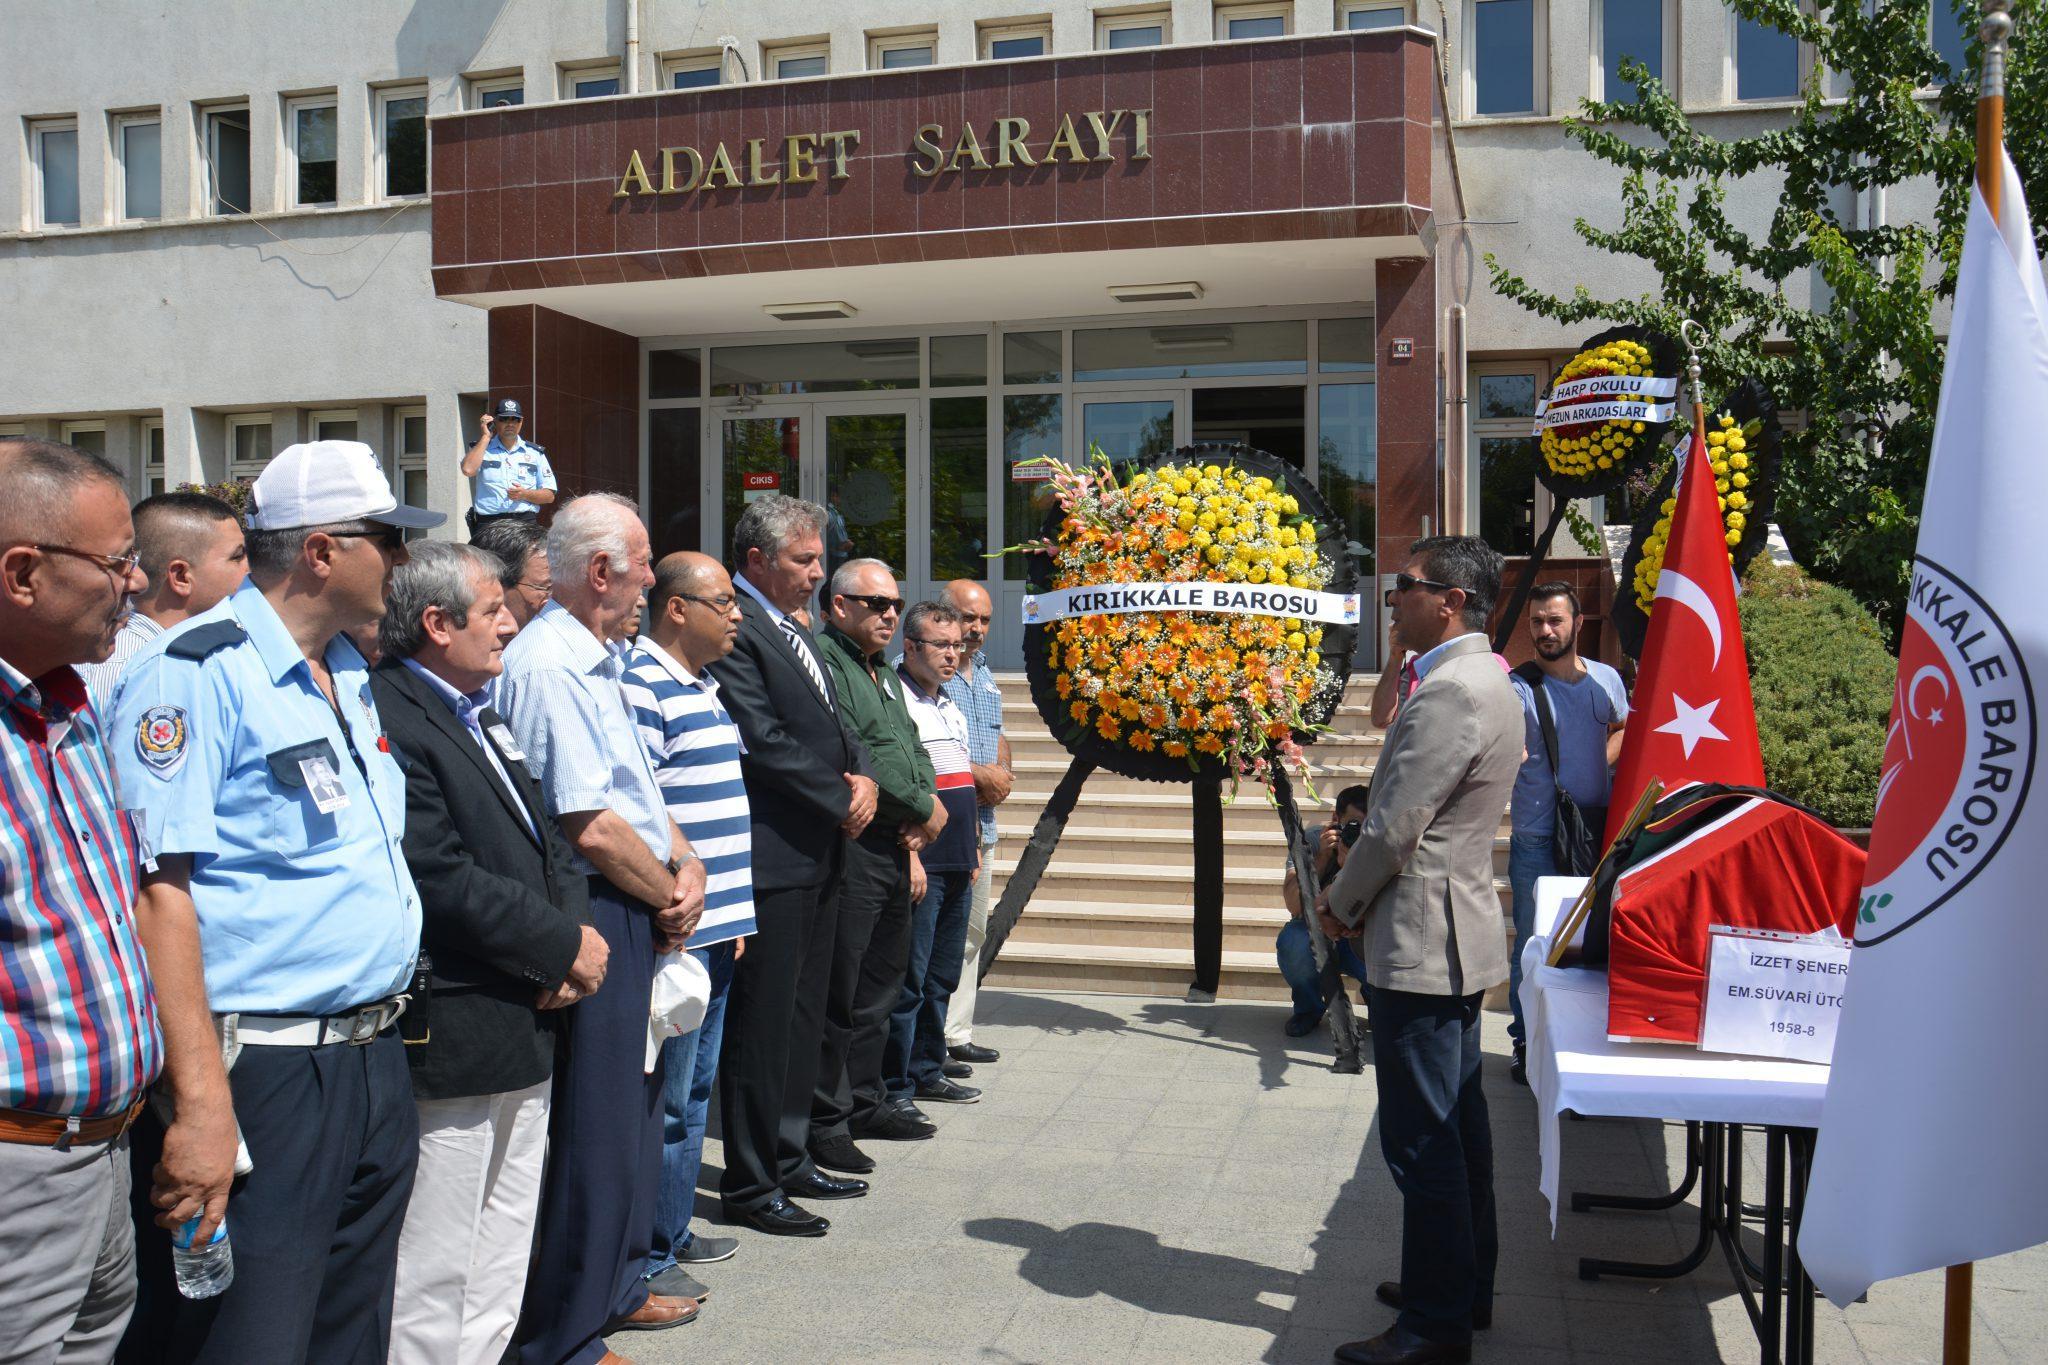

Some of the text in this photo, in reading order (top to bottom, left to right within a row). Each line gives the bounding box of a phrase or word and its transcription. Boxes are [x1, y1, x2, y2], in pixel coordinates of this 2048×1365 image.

[614, 108, 1152, 197] ADALET SARAYI
[1556, 383, 1587, 399] HARP
[1589, 380, 1642, 393] OKULU
[1546, 405, 1647, 424] MEZUN ARKADAŞLARI
[1068, 589, 1318, 615] KIRIKKALE BAROSU
[1926, 699, 2017, 882] BAROSU
[1750, 952, 1848, 975] İZZET ŞENER
[1728, 985, 1812, 1004] EM.SÜVARİ
[1769, 1021, 1815, 1036] 1958-8
